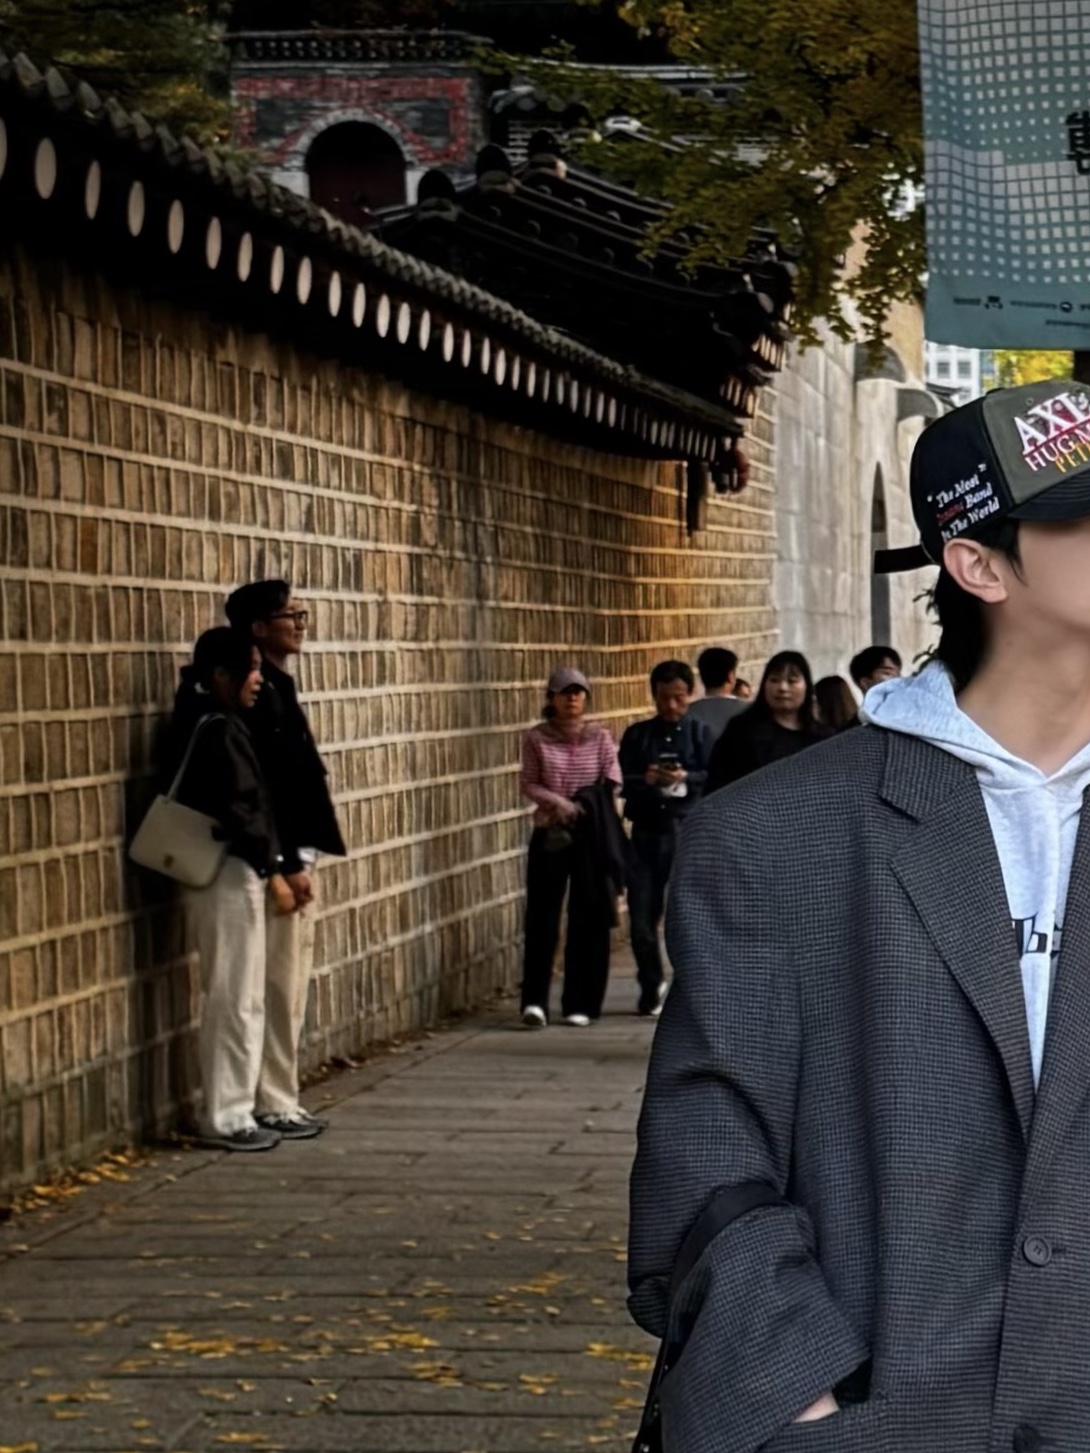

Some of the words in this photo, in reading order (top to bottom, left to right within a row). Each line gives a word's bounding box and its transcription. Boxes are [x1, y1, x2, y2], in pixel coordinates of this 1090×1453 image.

[1024, 434, 1077, 472] HUG
[964, 481, 993, 509] Band
[949, 518, 969, 536] The
[966, 495, 1000, 524] World
